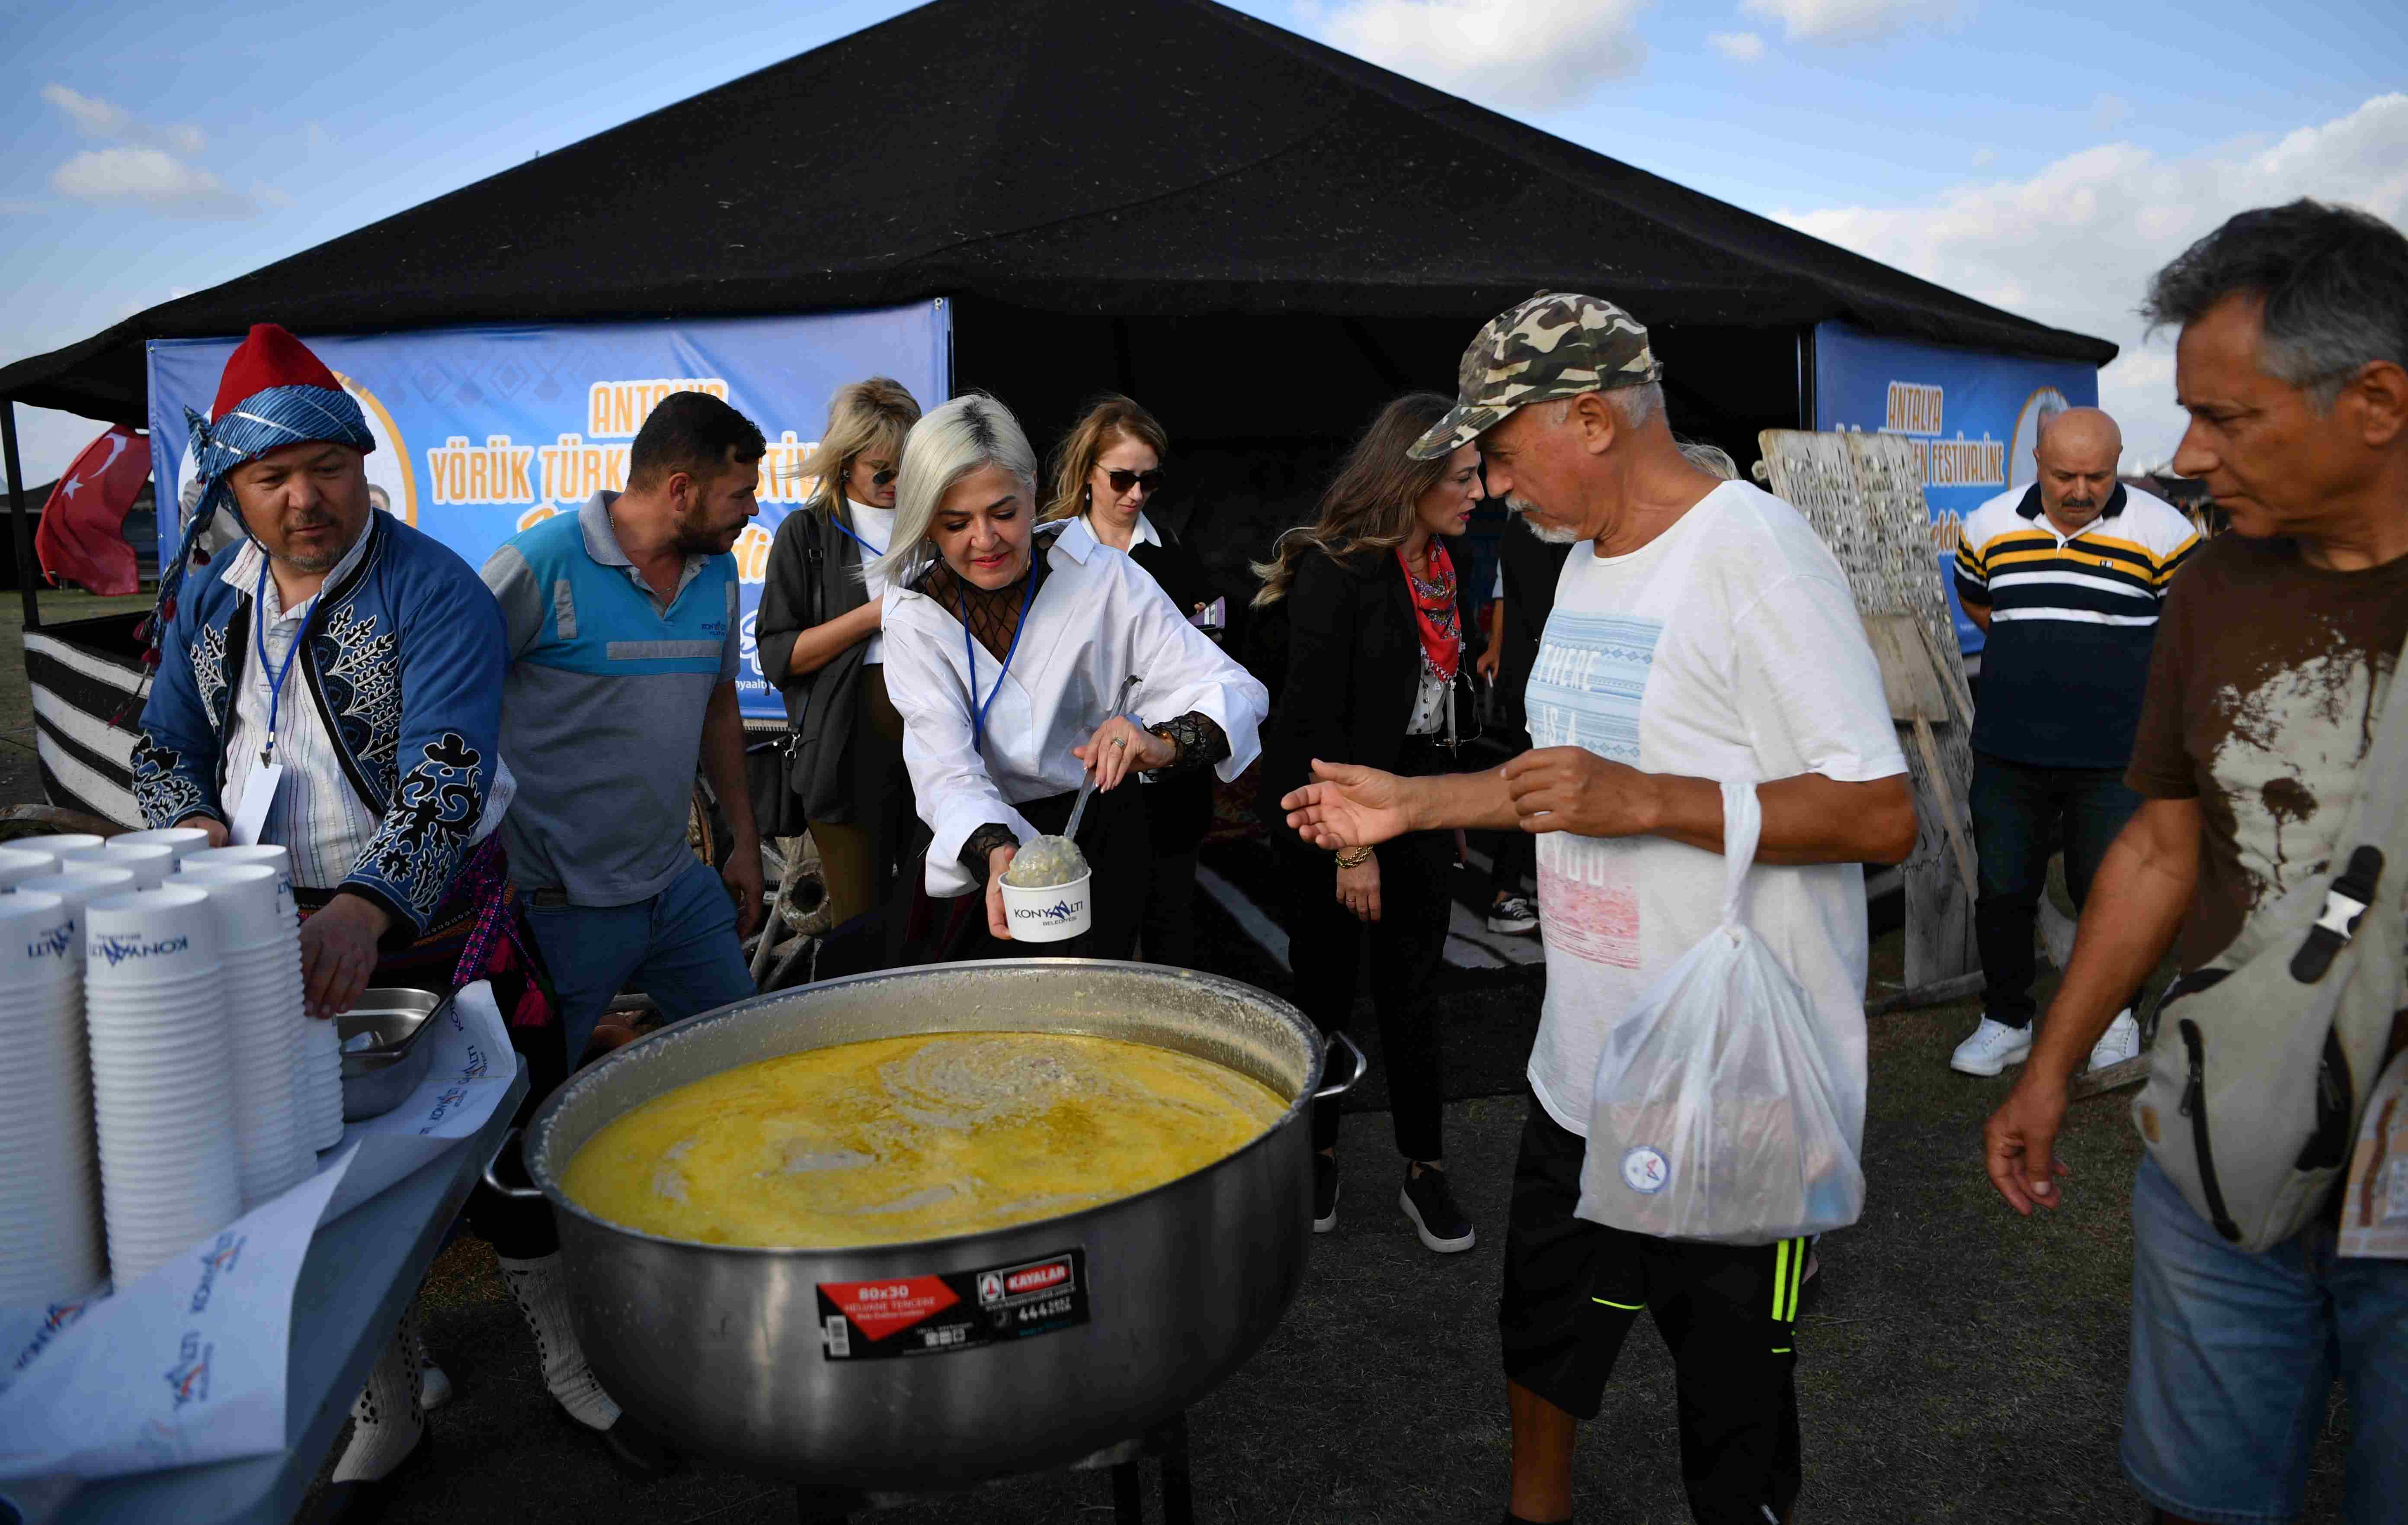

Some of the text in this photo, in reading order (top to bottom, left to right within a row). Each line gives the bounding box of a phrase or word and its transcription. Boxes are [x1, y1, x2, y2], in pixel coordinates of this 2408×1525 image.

[1888, 384, 1942, 433] ANTALYA
[430, 437, 631, 500] YÖRÜK TÜRK
[1931, 432, 2004, 484] FESTİVALİNE
[1536, 643, 1601, 691] THERE
[1543, 705, 1558, 745] IS
[1014, 899, 1083, 920] KONYAALTI
[859, 1285, 909, 1301] 80x30
[1009, 1266, 1066, 1290] KAYALAR
